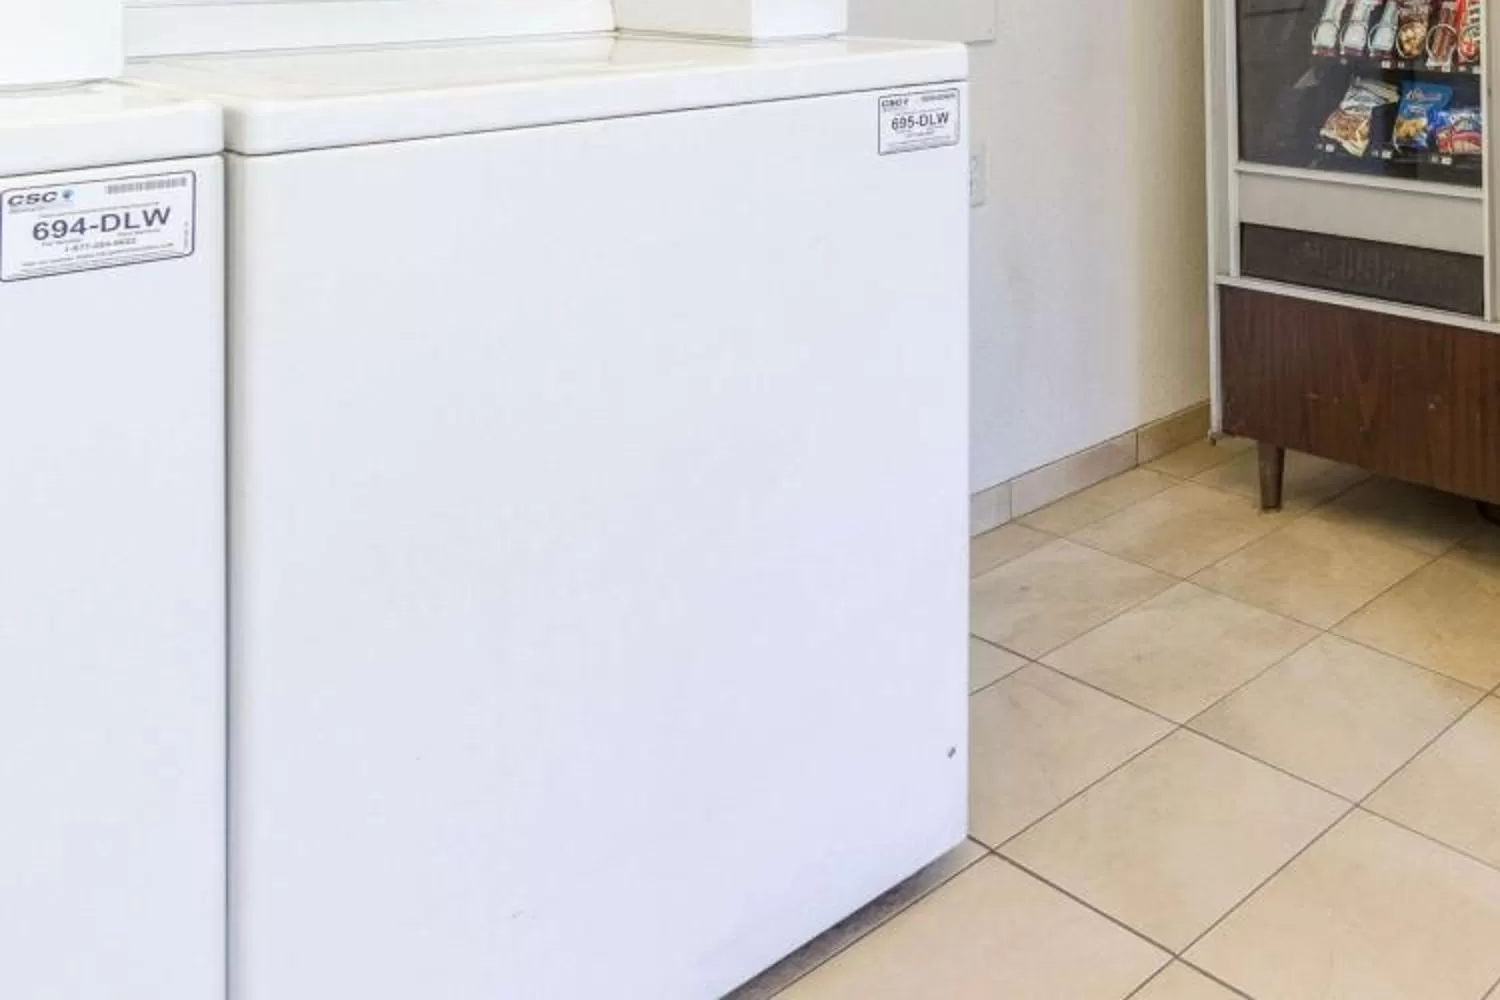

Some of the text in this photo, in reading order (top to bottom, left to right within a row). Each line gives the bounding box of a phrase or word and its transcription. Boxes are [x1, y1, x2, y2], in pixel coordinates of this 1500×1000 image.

[891, 111, 949, 130] 695-DLW
[7, 191, 59, 207] CSC
[33, 206, 171, 241] 694-DLW
